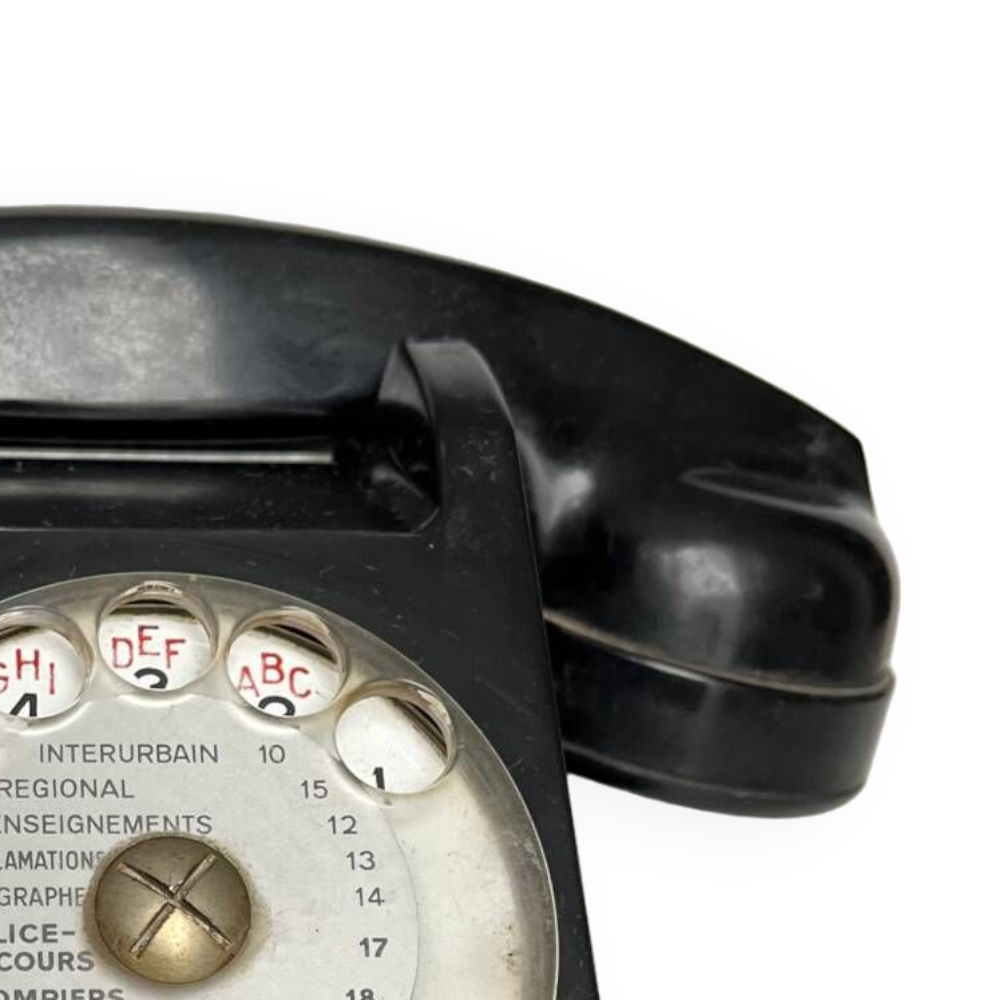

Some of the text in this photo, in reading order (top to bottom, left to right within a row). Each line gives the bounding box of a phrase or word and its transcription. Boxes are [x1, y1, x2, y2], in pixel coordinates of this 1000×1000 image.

[39, 743, 286, 764] INTERURBAIN 10
[300, 779, 328, 799] 15
[327, 815, 358, 835] 12
[346, 850, 376, 871] 13
[355, 887, 385, 907] 14
[359, 937, 388, 958] 17
